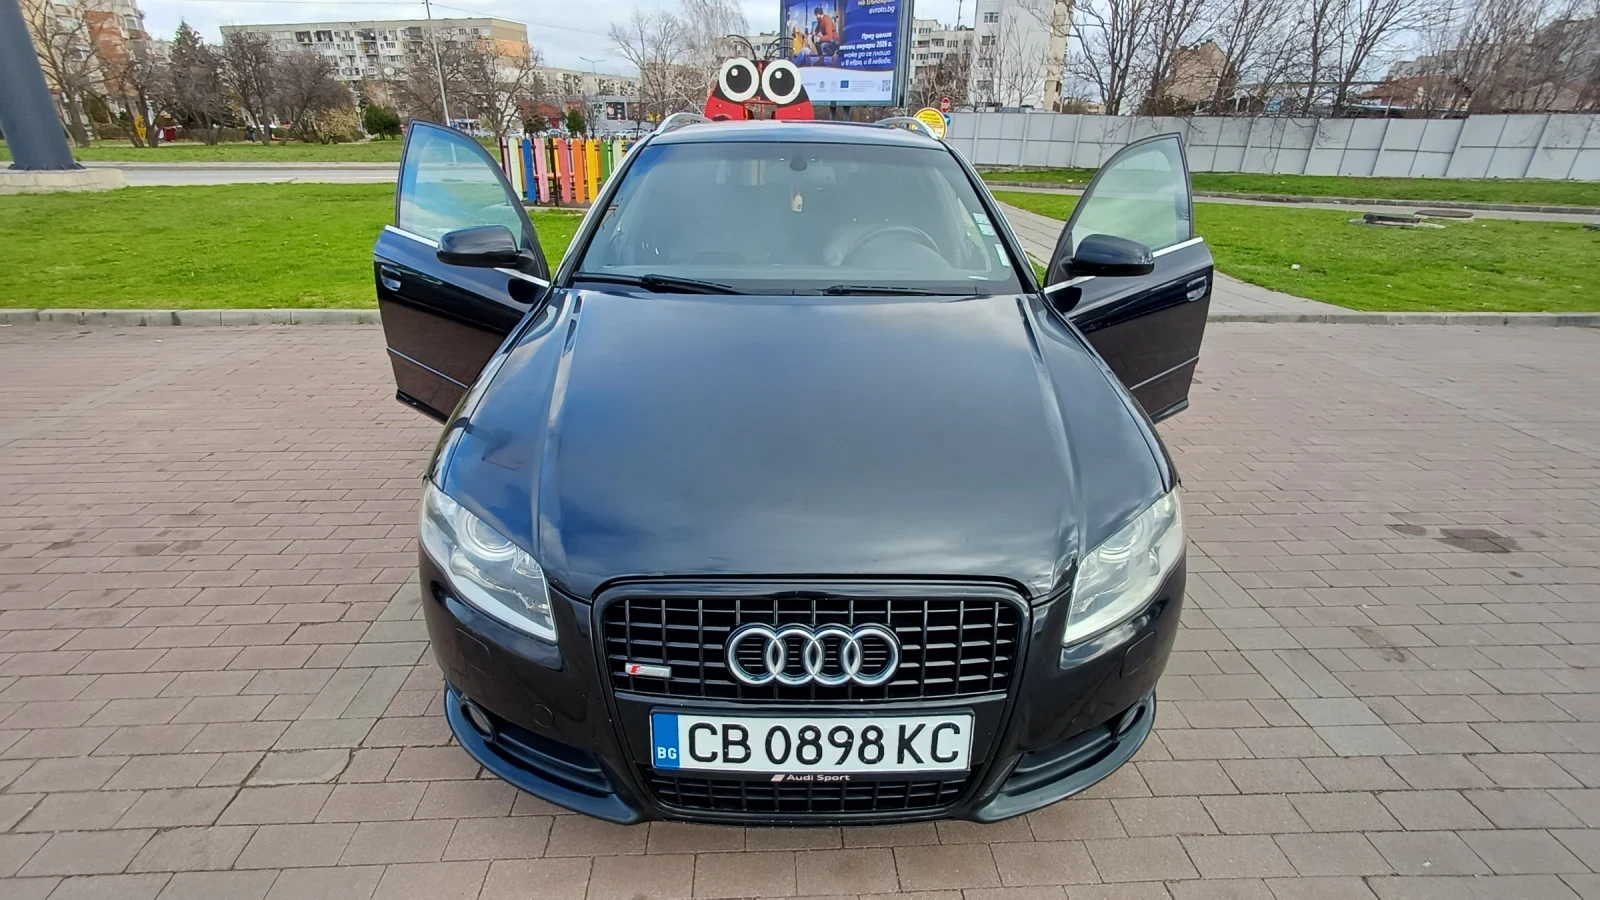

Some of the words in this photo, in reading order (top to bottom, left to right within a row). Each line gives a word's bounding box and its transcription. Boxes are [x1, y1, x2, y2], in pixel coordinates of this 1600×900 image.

[688, 721, 752, 763] CB
[765, 724, 885, 765] 0898
[897, 721, 961, 764] KC
[657, 746, 677, 760] BG
[817, 774, 851, 783] Sport
